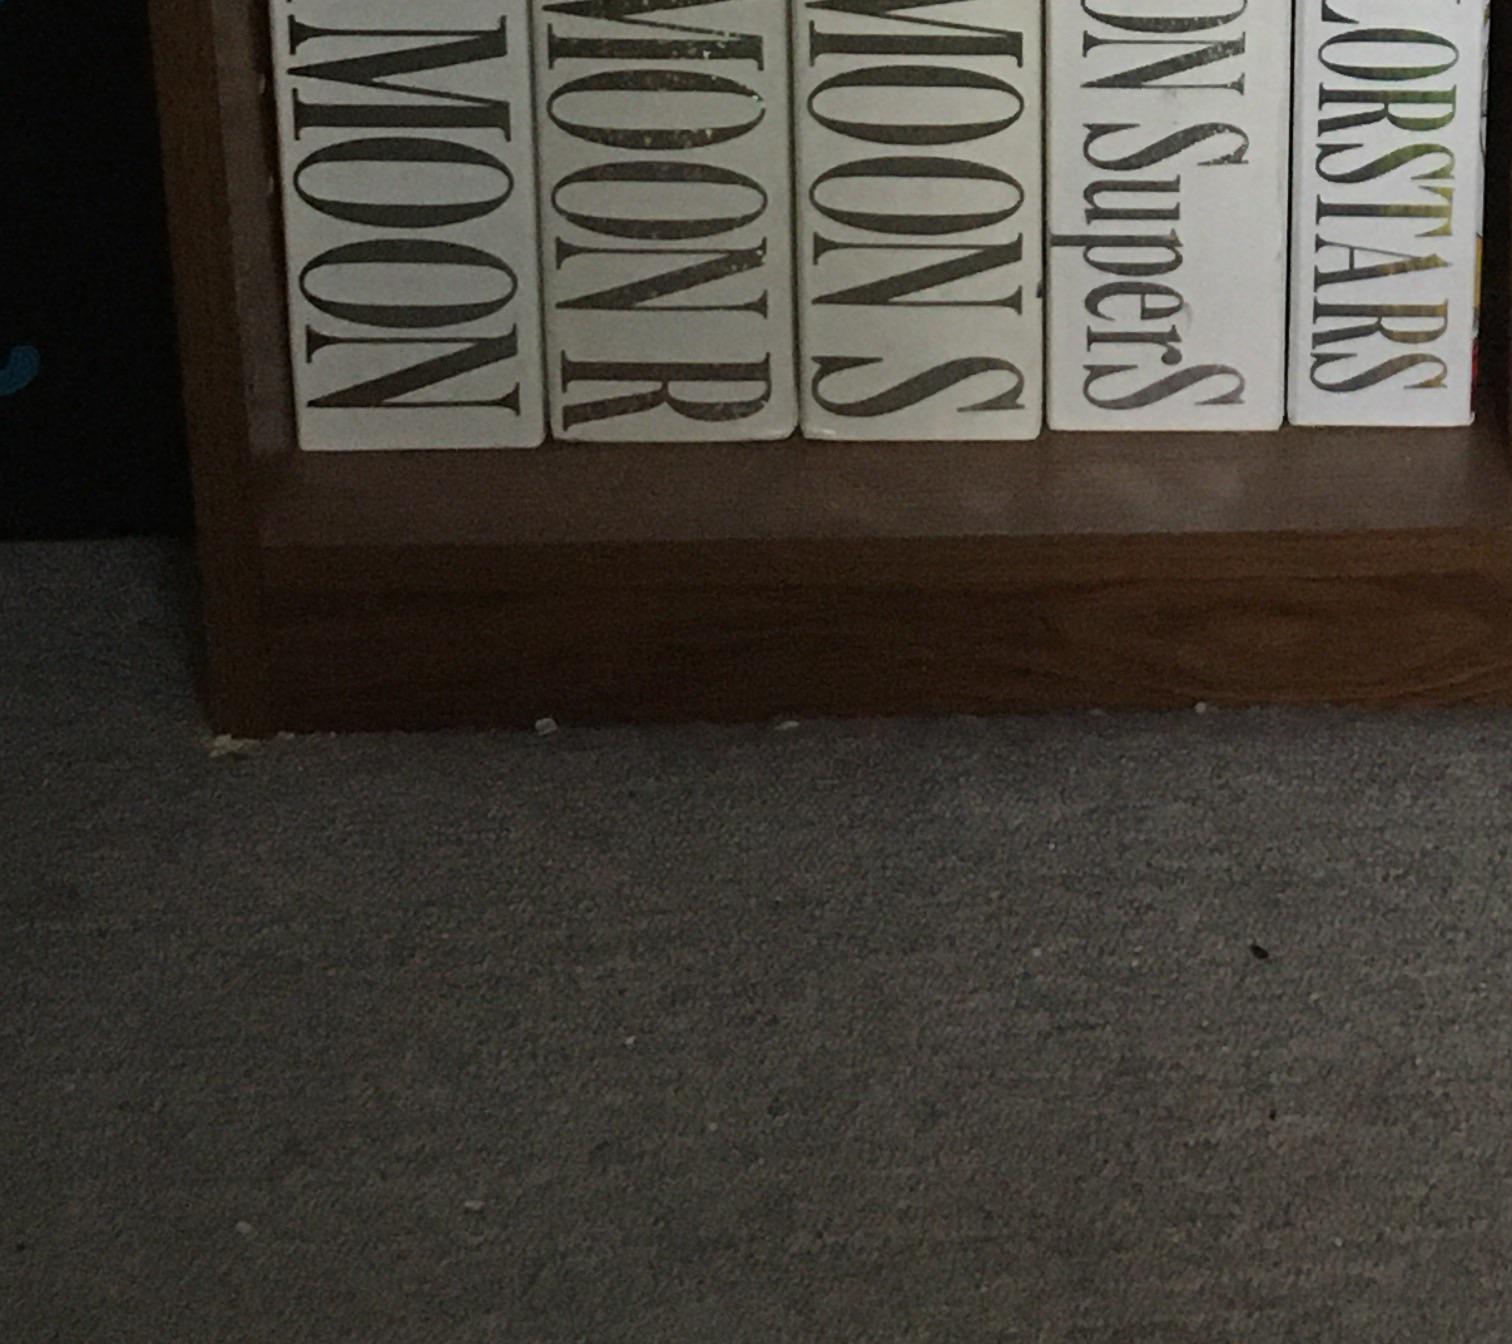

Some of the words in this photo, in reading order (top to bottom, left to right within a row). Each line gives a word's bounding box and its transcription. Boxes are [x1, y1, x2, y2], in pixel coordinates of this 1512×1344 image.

[1049, 120, 1251, 411] SuperS
[560, 350, 772, 432] R
[810, 354, 1026, 419] S
